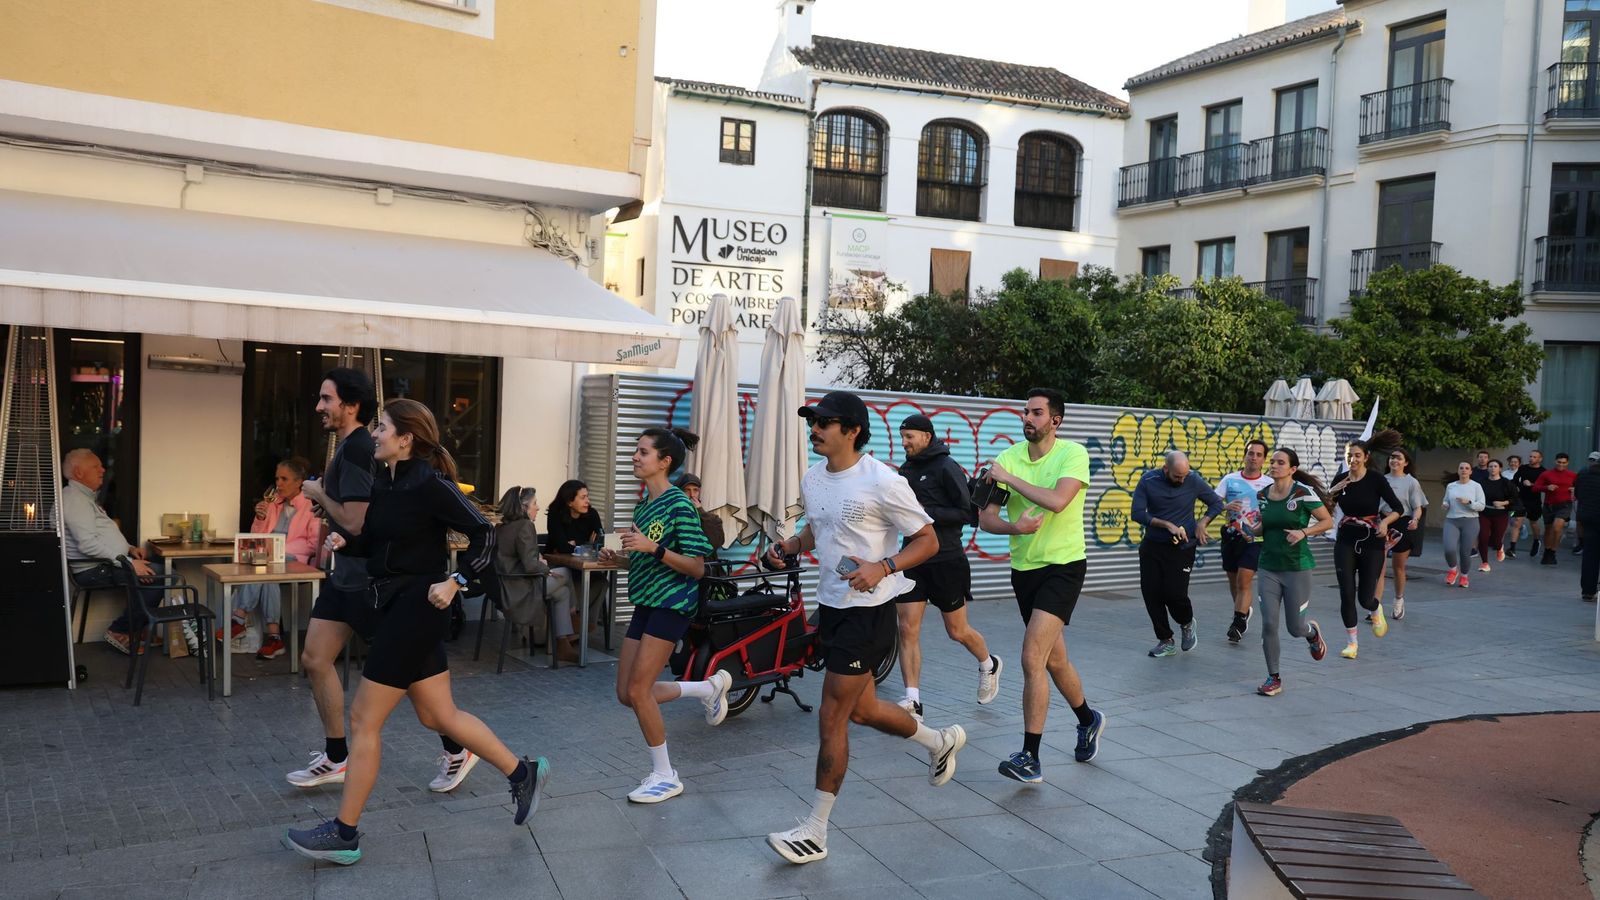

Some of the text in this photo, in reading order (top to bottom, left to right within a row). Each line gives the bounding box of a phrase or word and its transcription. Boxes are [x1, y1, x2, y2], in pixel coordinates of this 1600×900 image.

[672, 215, 788, 263] MUSEO
[736, 245, 778, 257] Fundación
[736, 254, 766, 264] Unicaja
[672, 267, 783, 293] DE ARTES
[671, 291, 682, 304] Y
